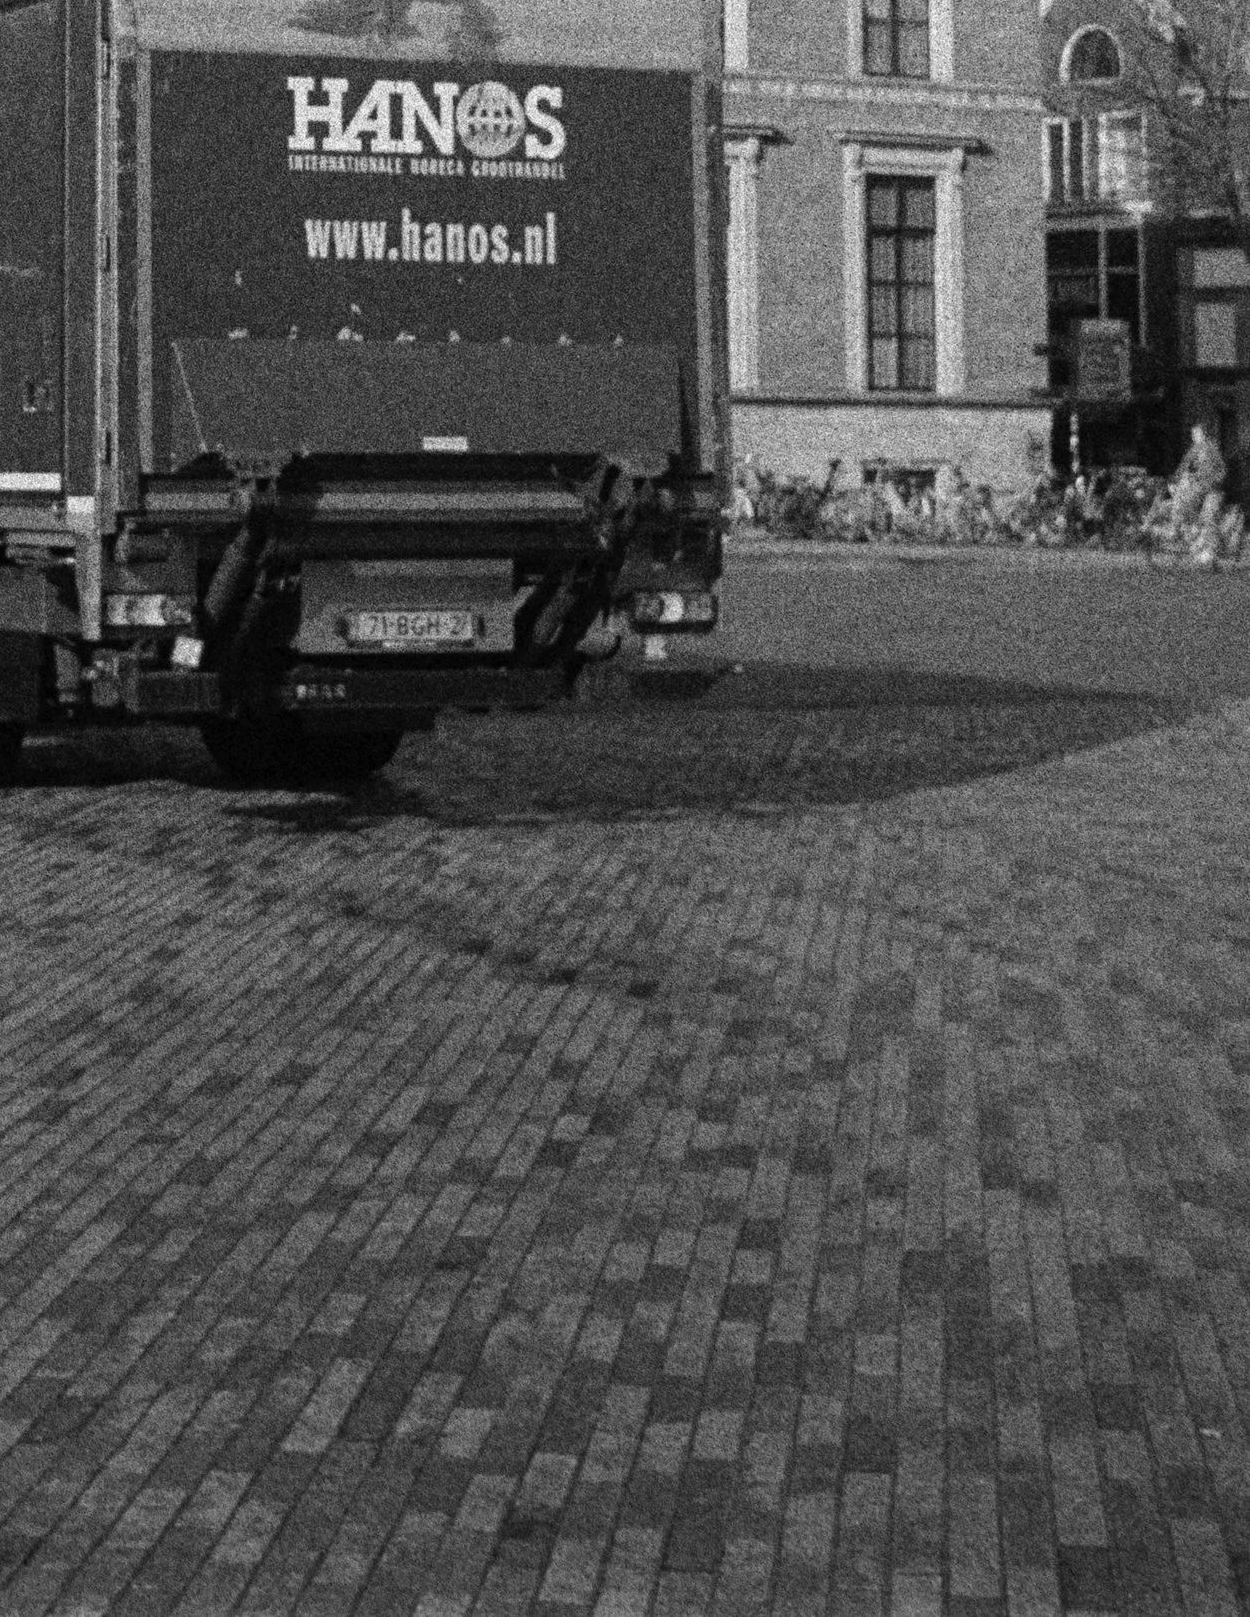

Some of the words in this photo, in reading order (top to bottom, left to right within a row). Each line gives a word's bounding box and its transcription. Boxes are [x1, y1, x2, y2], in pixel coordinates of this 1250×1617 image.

[287, 76, 567, 160] HANOS
[288, 154, 403, 175] INTERNATIONALE
[410, 158, 465, 177] HORECA
[471, 161, 566, 181] GROOTHANDEL
[304, 207, 557, 265] www.hanos.nl
